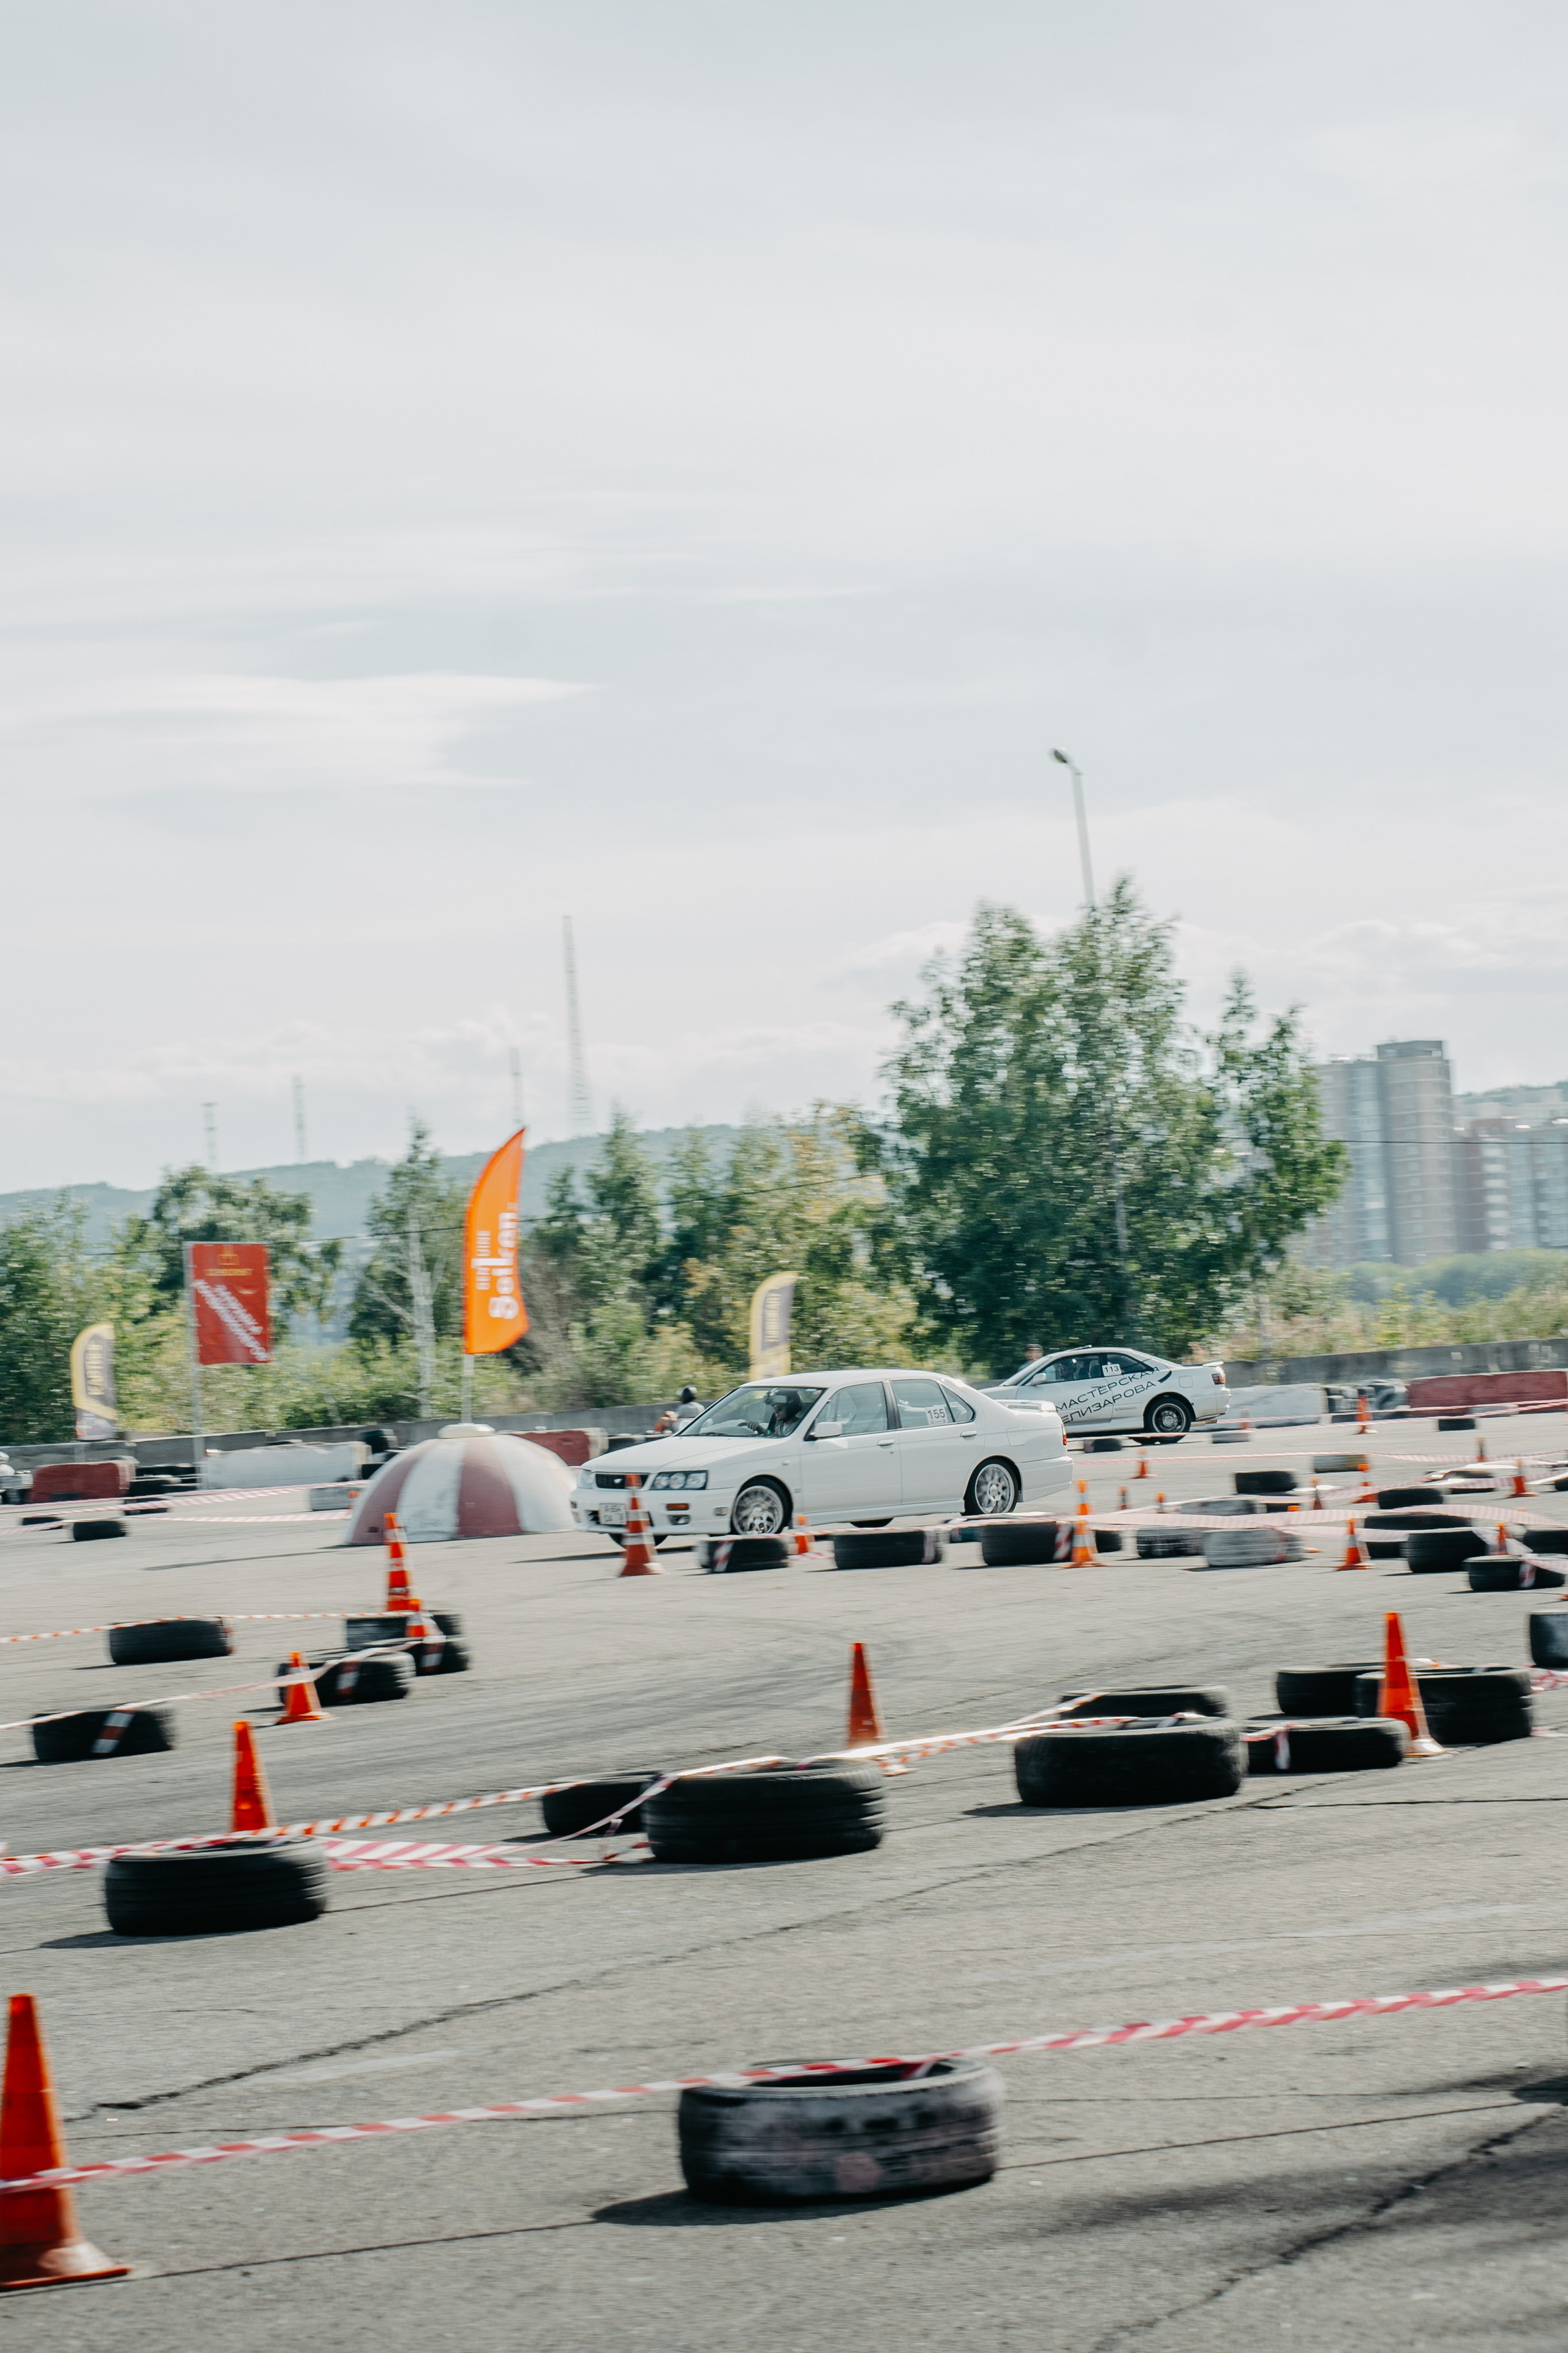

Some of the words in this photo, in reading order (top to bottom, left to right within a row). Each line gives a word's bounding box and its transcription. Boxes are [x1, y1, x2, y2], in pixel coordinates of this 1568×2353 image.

[471, 1212, 519, 1320] Seiken
[1055, 1366, 1159, 1413] МАСТЕРСКАЯ
[1061, 1380, 1156, 1424] ЕЛИЗАРОВА
[928, 1408, 945, 1419] 155
